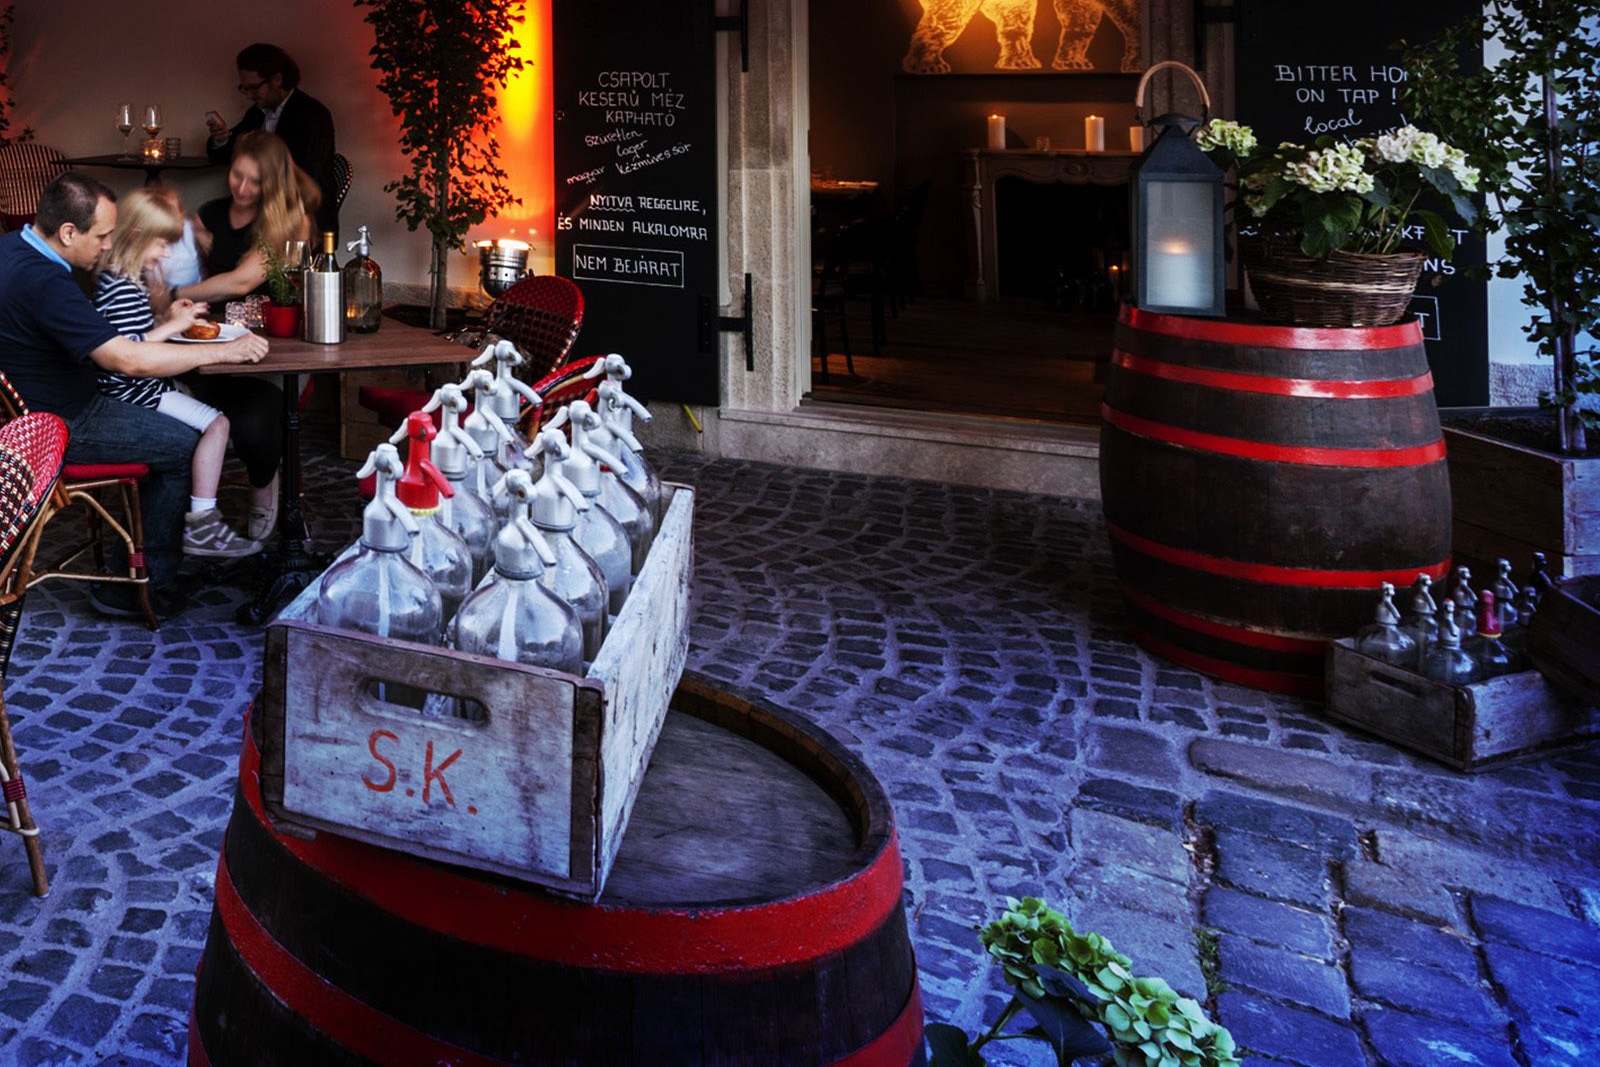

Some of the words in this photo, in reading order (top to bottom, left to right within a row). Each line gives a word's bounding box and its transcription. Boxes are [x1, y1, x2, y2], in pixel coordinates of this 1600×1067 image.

[598, 71, 671, 89] CSAPOLT
[1274, 64, 1357, 82] BITTER
[651, 88, 686, 110] MÉZ
[1295, 87, 1325, 103] ON
[1337, 88, 1380, 104] TAP
[605, 110, 676, 127] KAPHATÓ
[1303, 108, 1363, 135] local
[566, 165, 606, 185] magyar
[589, 194, 633, 209] NYITVA
[557, 212, 573, 230] ÉS
[579, 216, 625, 232] MINDEN
[631, 221, 708, 242] ALKALOMRA
[574, 254, 608, 272] NEM
[612, 254, 681, 279] BEJÁRAT
